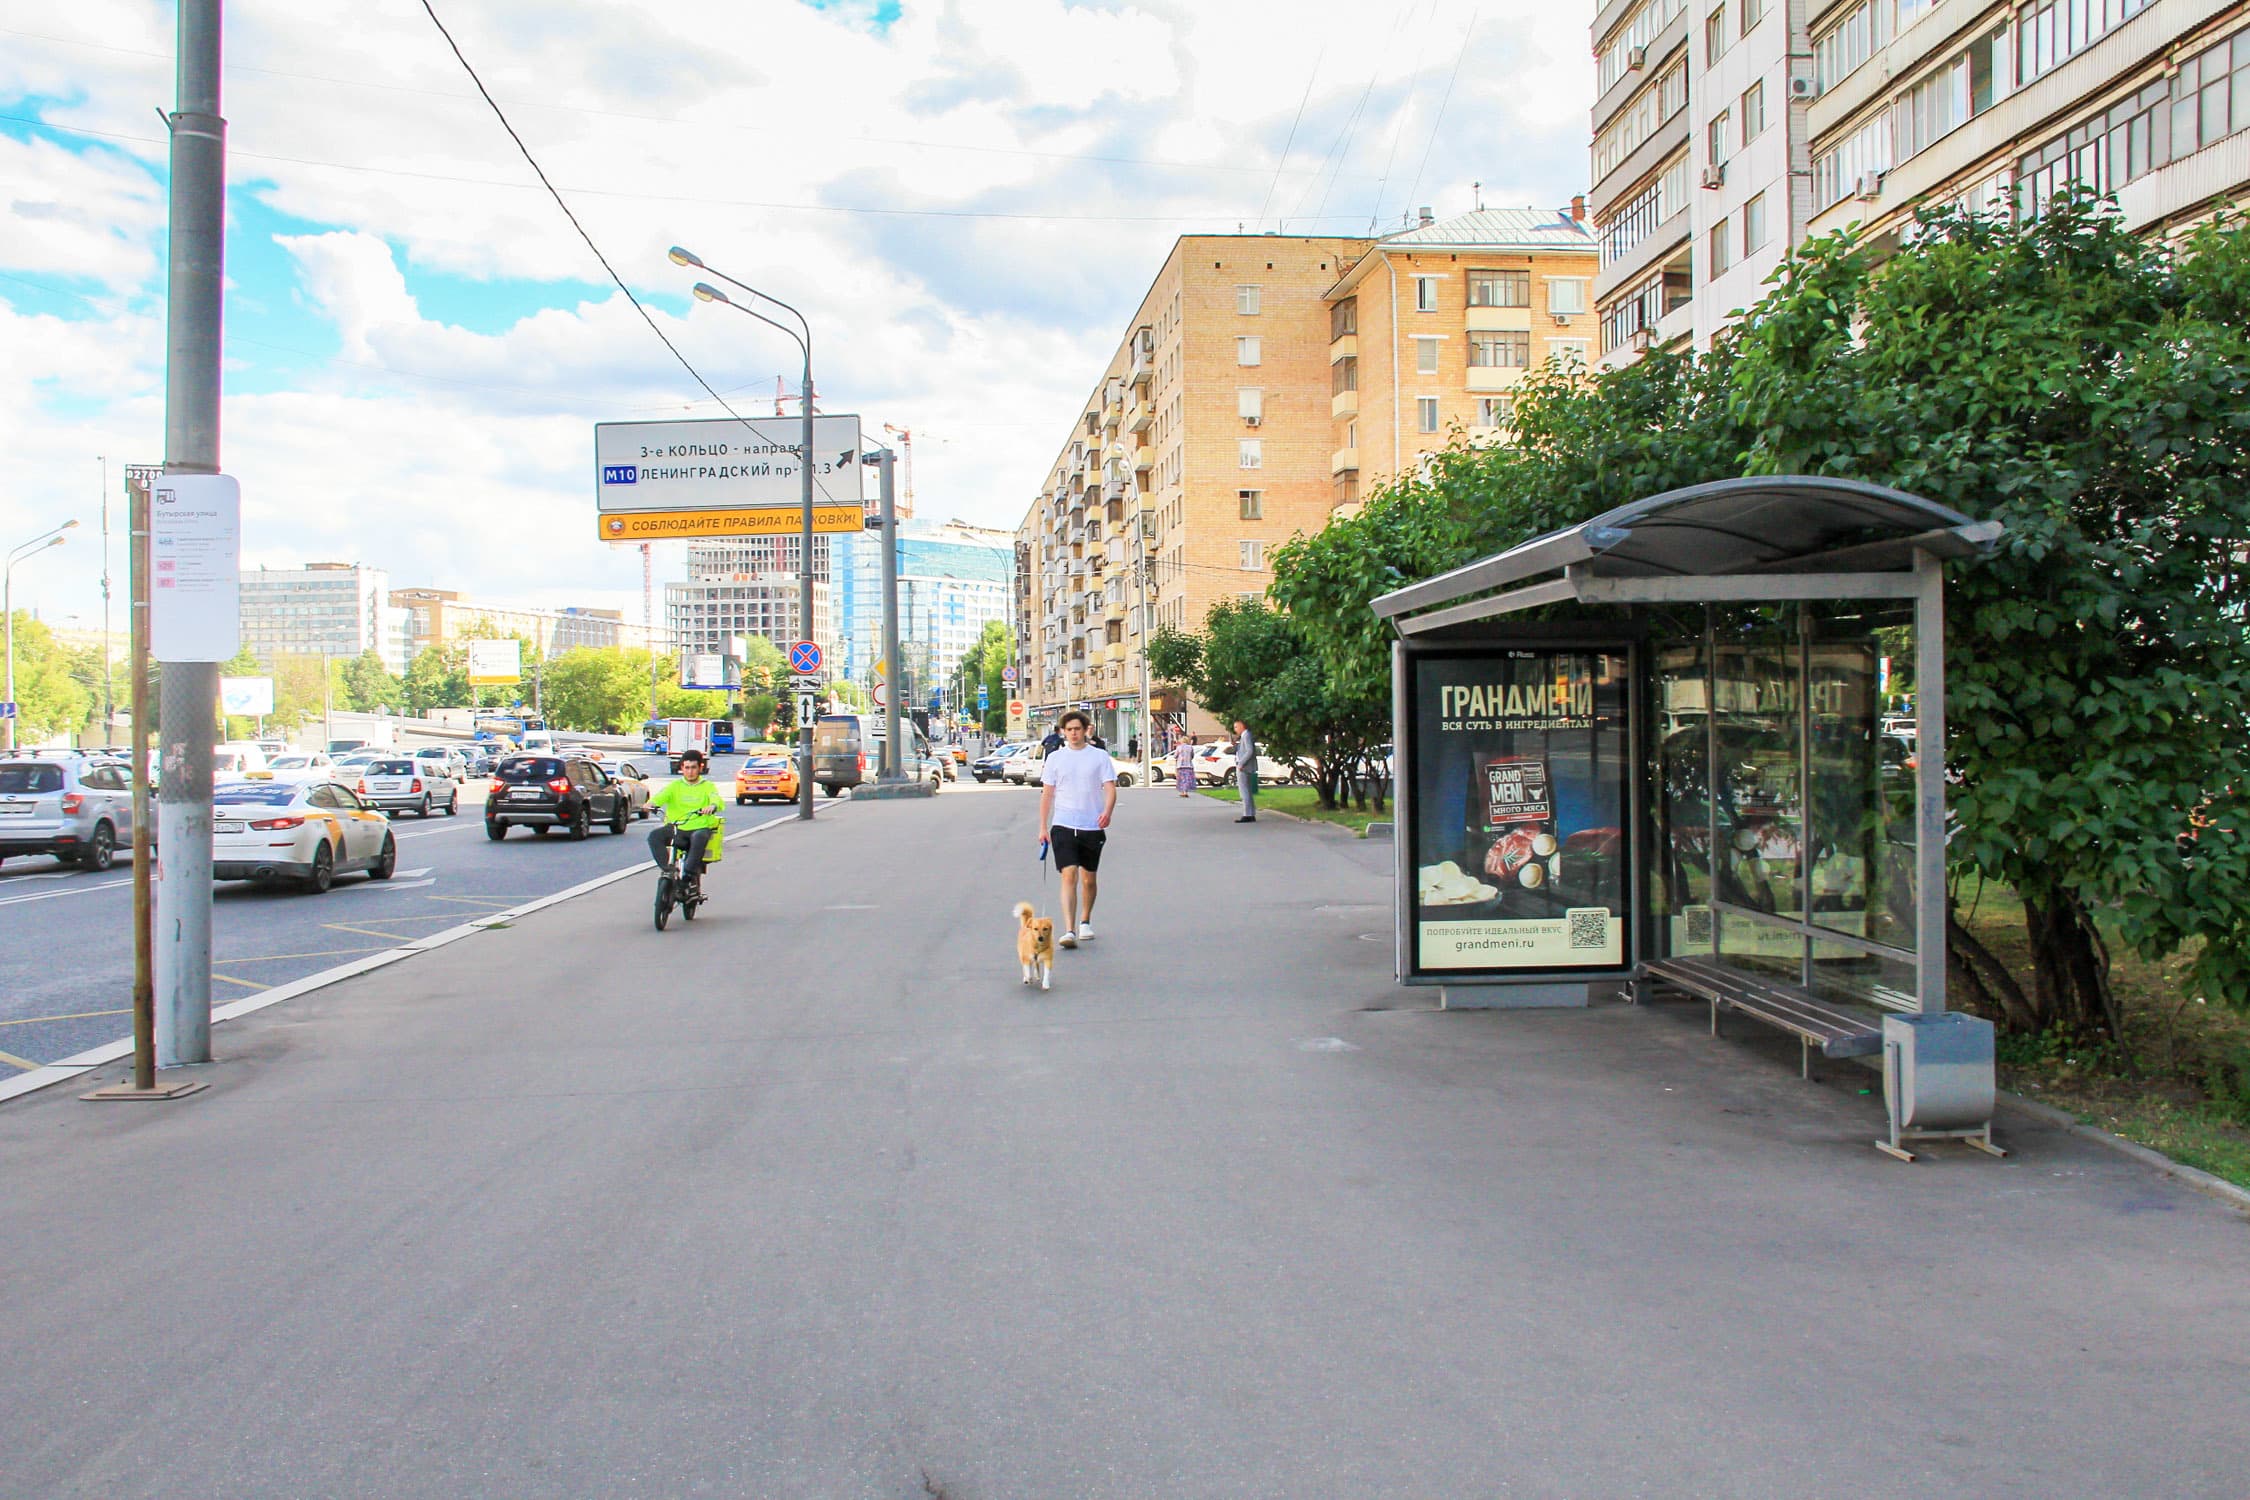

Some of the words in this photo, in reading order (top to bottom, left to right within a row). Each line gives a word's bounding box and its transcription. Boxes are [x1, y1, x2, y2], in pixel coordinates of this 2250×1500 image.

[640, 446, 663, 458] 3-е
[669, 443, 728, 457] КОЛЬЦО
[606, 469, 635, 481] М10
[640, 462, 770, 480] ЛЕНИНГРАДСКИЙ
[776, 465, 803, 478] пр-
[632, 517, 720, 531] СОБЛЮДАЙТЕ
[723, 515, 782, 528] ПРАВИЛА
[785, 513, 856, 526] ПАКОВКИ!
[1441, 684, 1593, 718] ГРАНДМЕНИ
[1442, 721, 1463, 731] ВСЯ
[1466, 720, 1493, 731] СУТЬ
[1495, 720, 1503, 730] В
[1505, 718, 1593, 731] ИНГРЕДИЕНТАХ!
[1489, 770, 1521, 783] GRAND
[1491, 782, 1524, 804] MENI
[1493, 806, 1521, 814] МНОГО
[1523, 804, 1546, 812] МЯСА
[1426, 927, 1481, 936] ПОПРОБУЙТЕ
[1485, 926, 1539, 936] ИДЕАЛЬНЫЙ
[1541, 926, 1562, 934] ВКУС
[1455, 938, 1534, 952] grandmeni.ru
